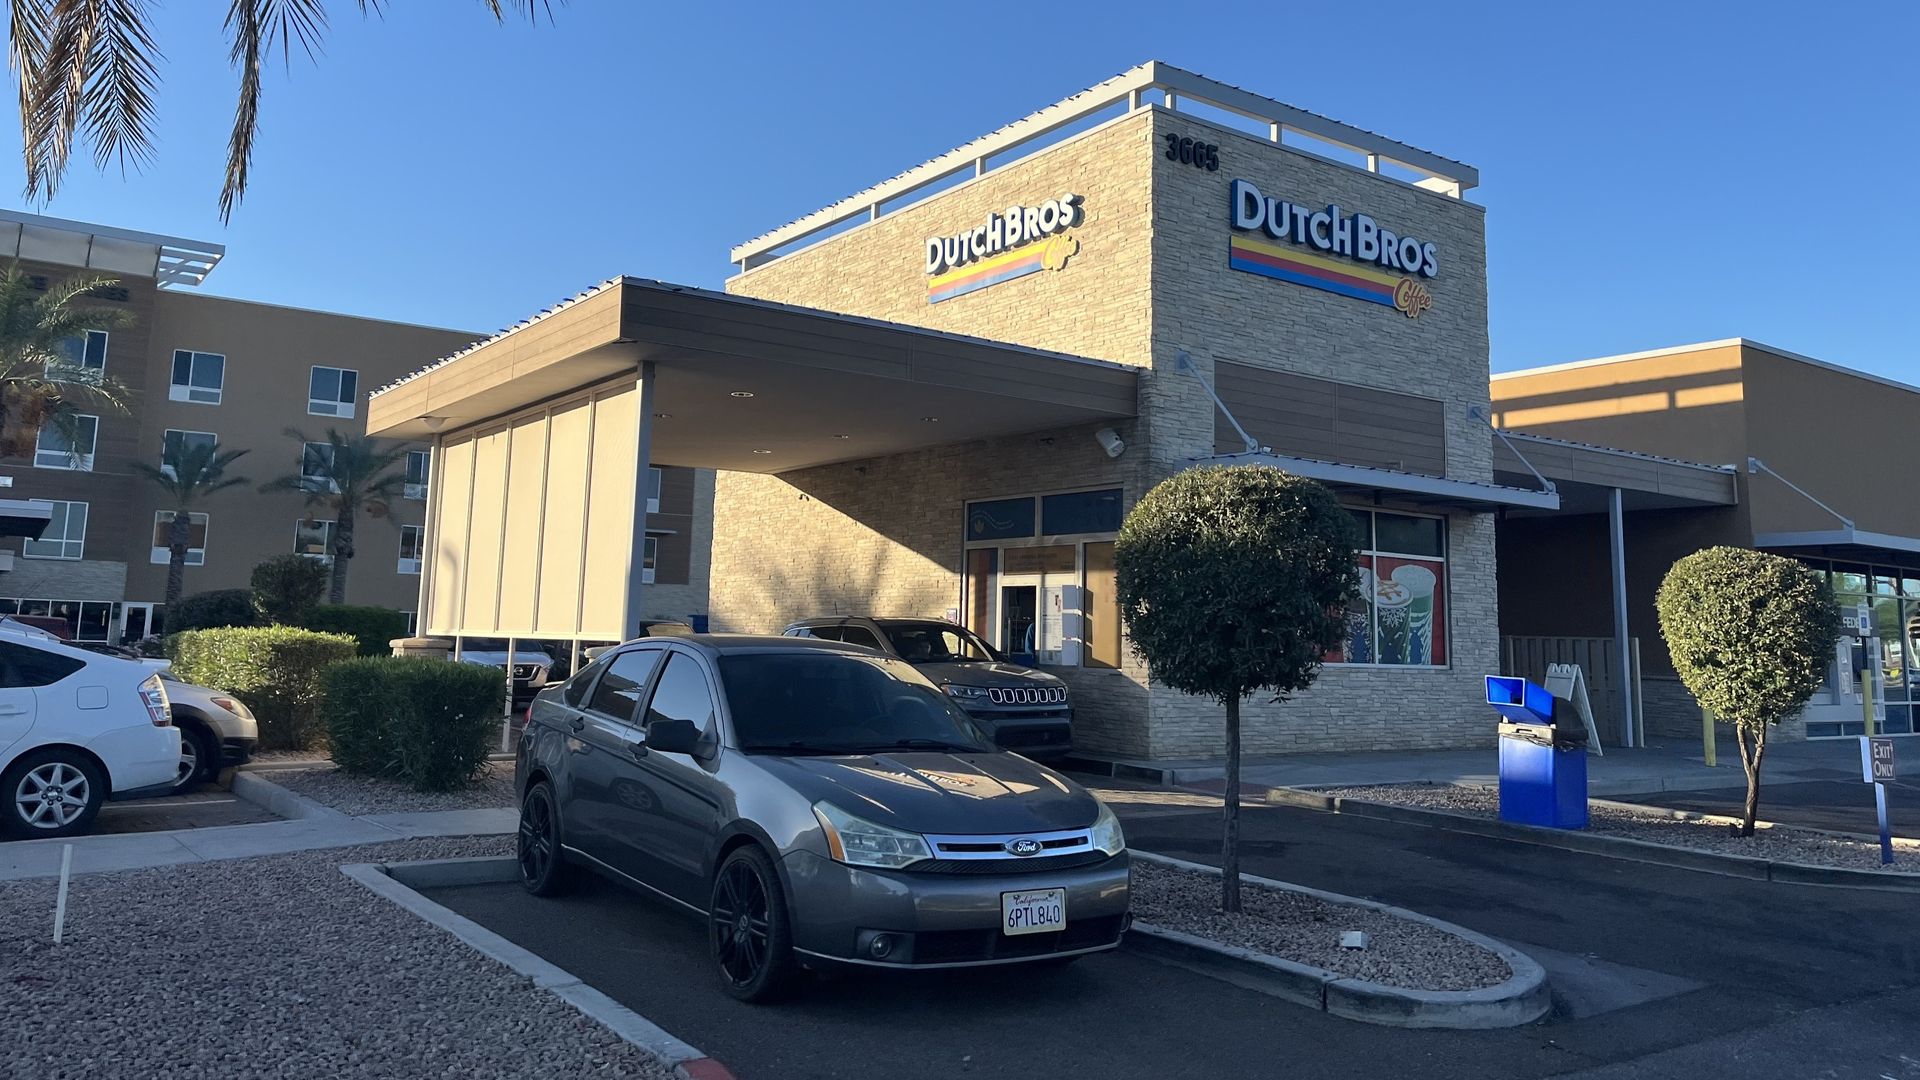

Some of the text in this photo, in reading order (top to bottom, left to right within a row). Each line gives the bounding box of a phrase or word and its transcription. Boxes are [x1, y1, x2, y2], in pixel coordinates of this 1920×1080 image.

[1166, 133, 1219, 171] 3665
[1394, 278, 1431, 316] Coffee
[1873, 742, 1891, 758] EXIT
[1874, 760, 1893, 776] ONLY
[1017, 841, 1036, 852] Ford
[1008, 905, 1061, 928] 6PTL840
